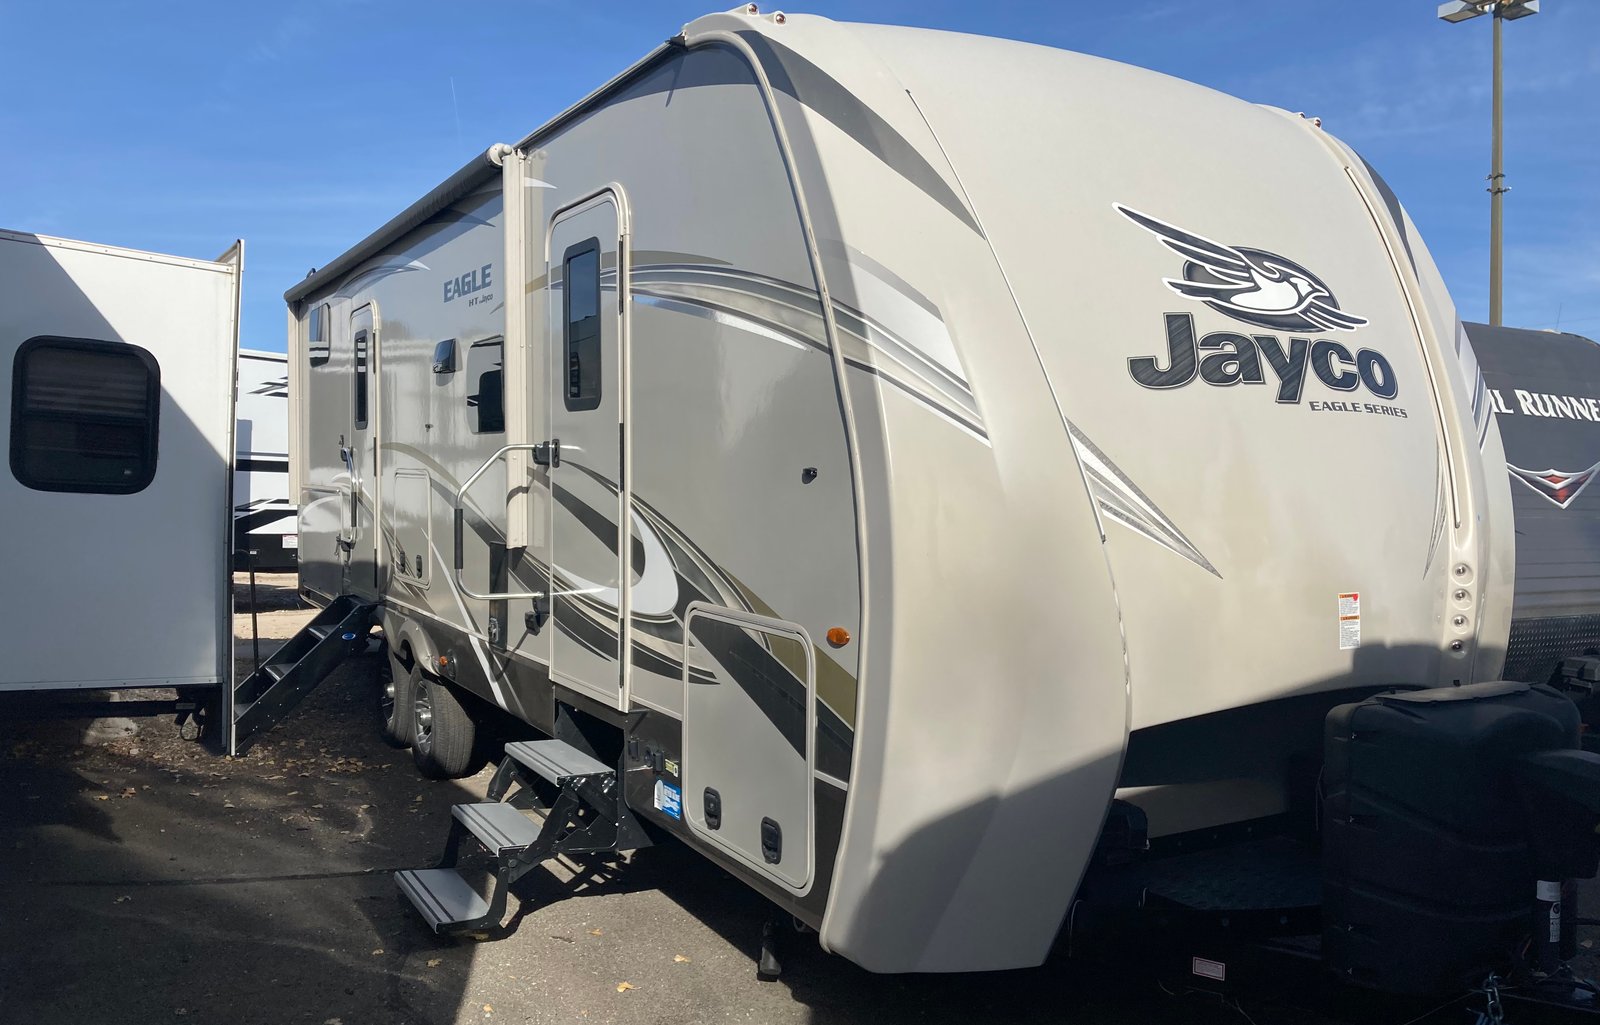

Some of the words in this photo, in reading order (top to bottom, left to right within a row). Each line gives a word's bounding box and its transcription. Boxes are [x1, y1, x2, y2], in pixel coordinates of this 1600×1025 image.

[443, 263, 492, 303] EAGLE
[468, 297, 479, 307] HT
[1127, 312, 1399, 404] Jayco
[1309, 401, 1362, 413] EAGLE
[1364, 403, 1408, 418] SERIES
[1514, 389, 1600, 422] RUNNE
